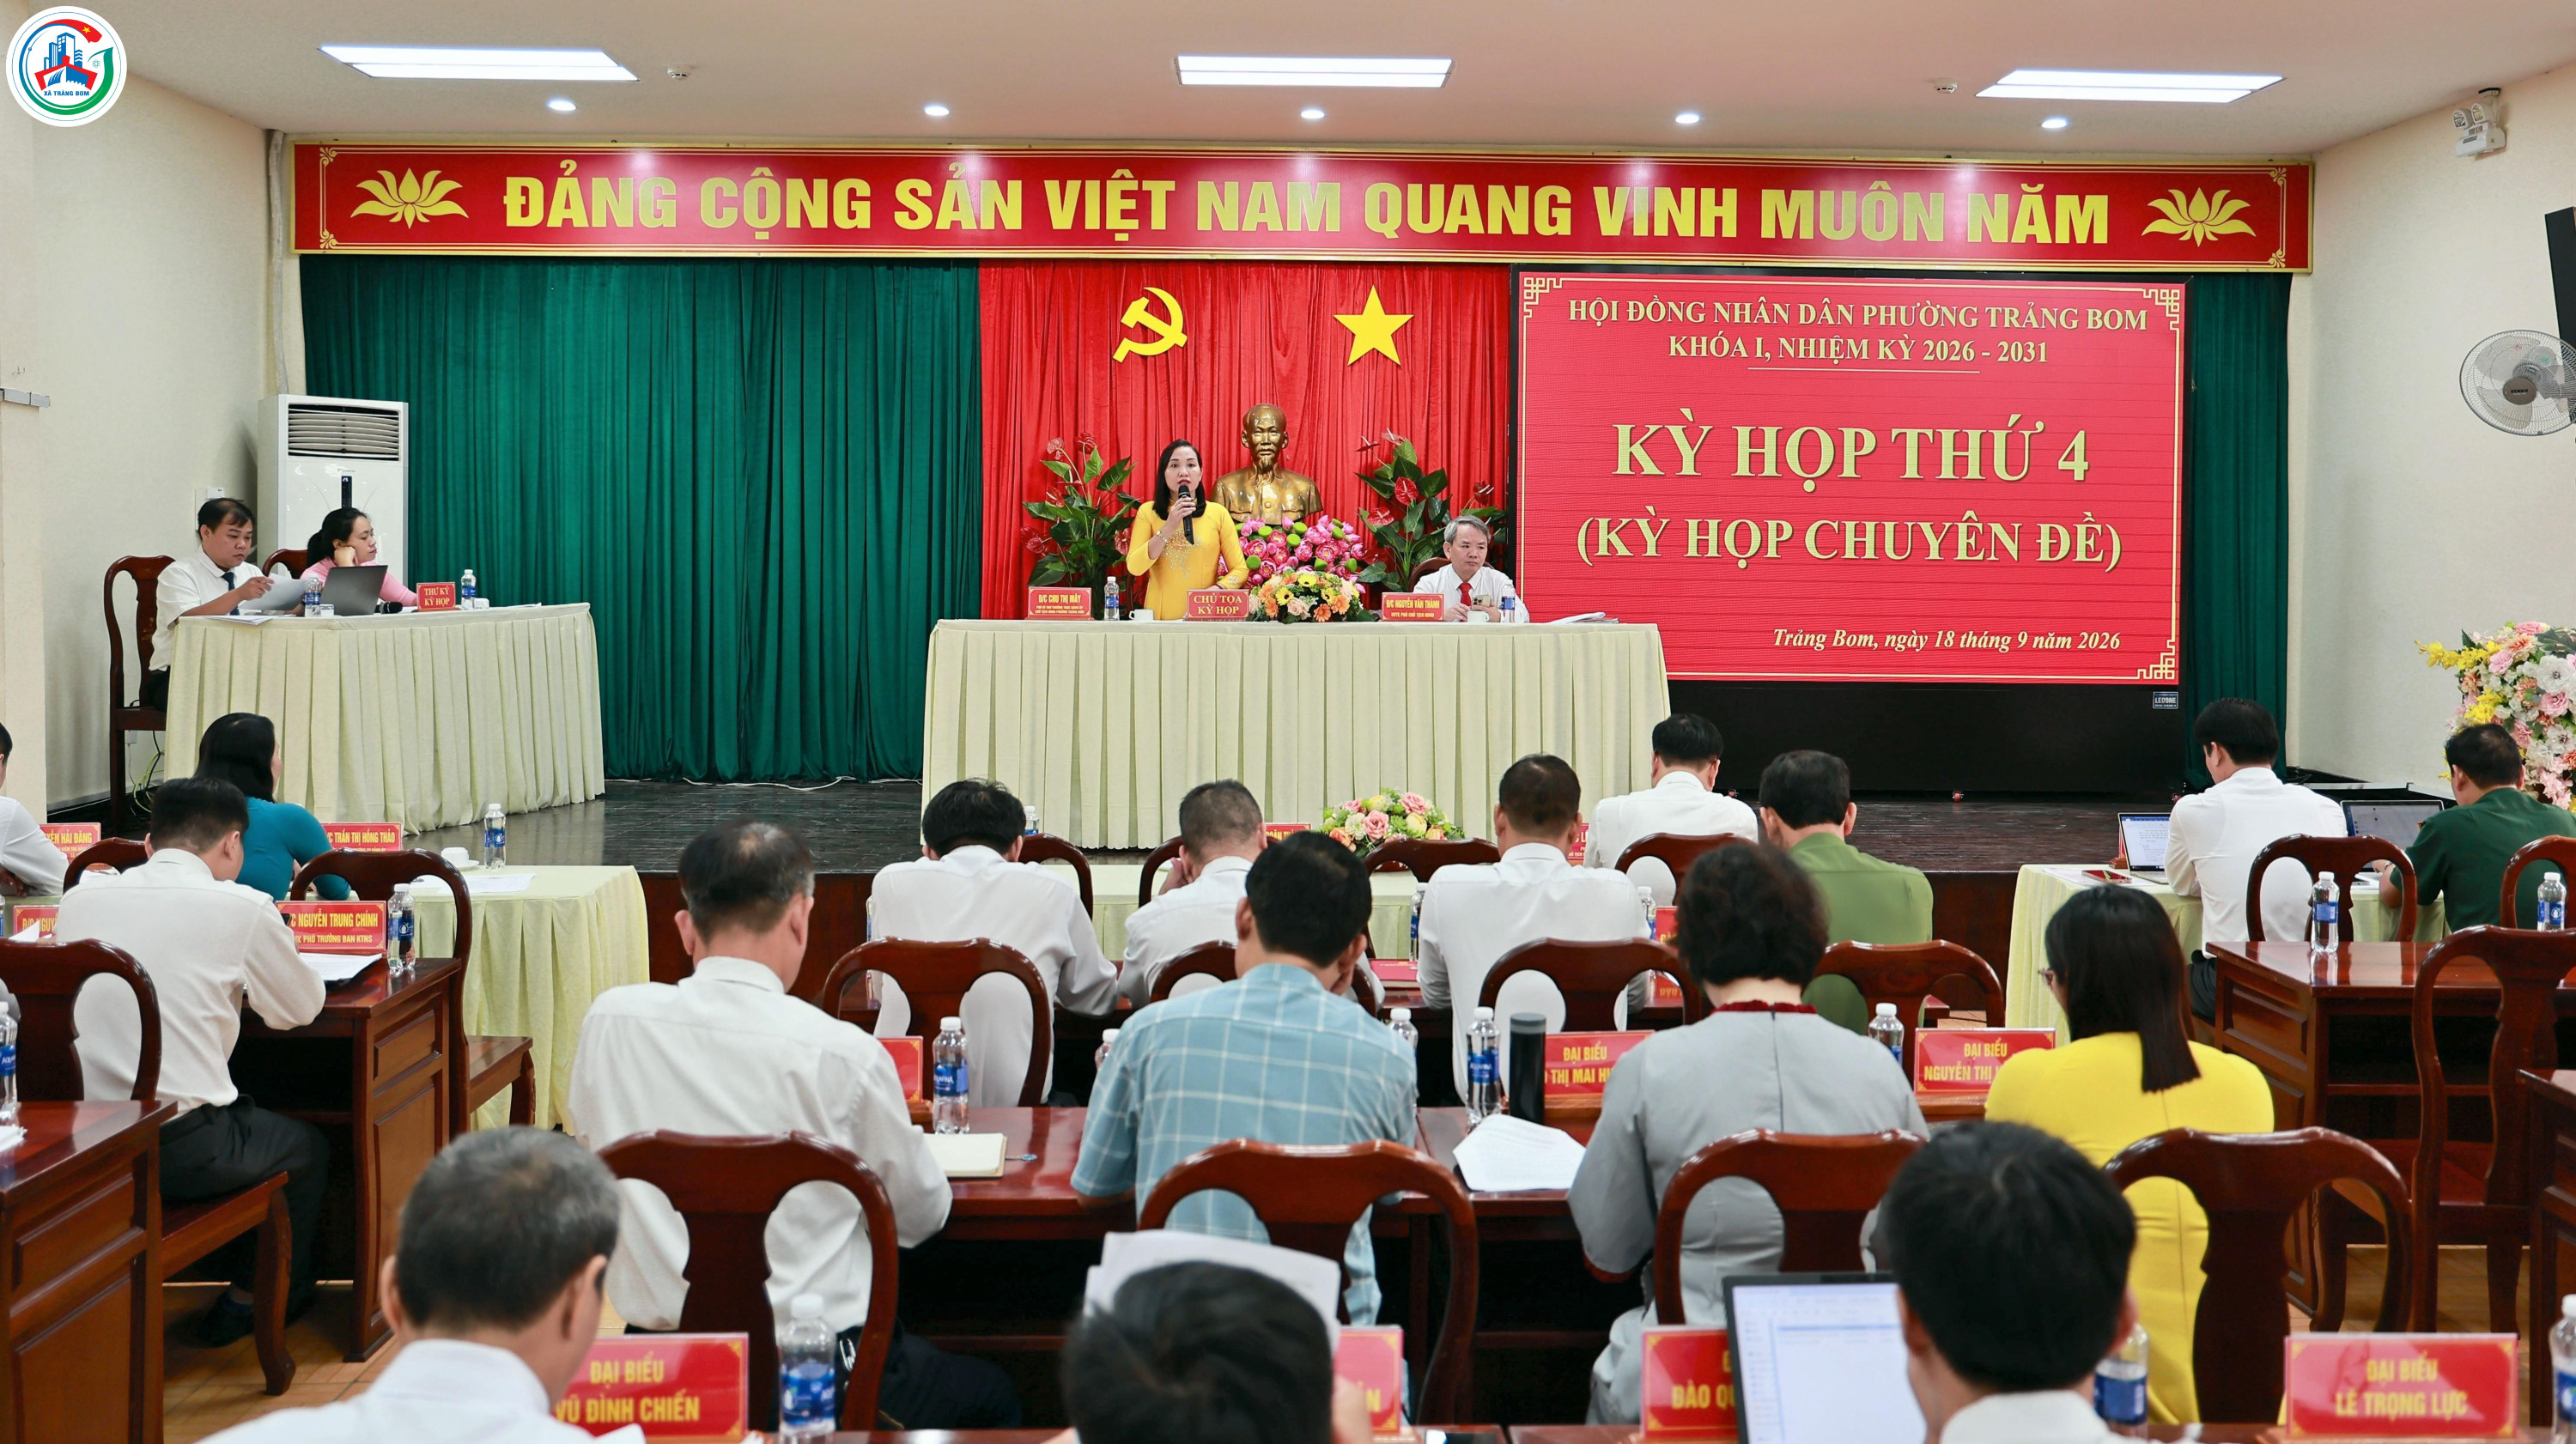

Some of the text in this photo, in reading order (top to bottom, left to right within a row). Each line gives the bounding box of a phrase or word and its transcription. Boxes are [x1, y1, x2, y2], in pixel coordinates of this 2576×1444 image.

[504, 159, 2109, 246] ĐẢNG CỘNG SẢN VIỆT NAM QUANG VINH MUÔN NĂM
[1570, 298, 2147, 330] HỘI ĐỒNG NHÂN DÂN PHƯỜNG TRẢNG BOM
[1668, 337, 1748, 357] KHÓA
[1755, 337, 1771, 361] I,
[1778, 336, 1869, 364] NHIỆM
[1877, 340, 1915, 360] KỲ
[1923, 340, 1974, 361] 2026
[1998, 342, 2046, 361] 2031
[1613, 409, 2088, 492] KỲ HỌP THỨ 4
[1578, 506, 2120, 572] (KỲ HỌP CHUYÊN ĐỀ)
[423, 586, 439, 596] THƯ
[424, 596, 451, 607] KỲ HỌP
[1048, 594, 1060, 604] CHU
[1060, 594, 1069, 605] THỊ
[1194, 592, 1242, 605] CHỦ TỌA
[1198, 604, 1239, 616] KỲ HỌP
[1774, 629, 2120, 652] Trảng Bom, ngày 18 tháng 9 năm 2026
[61, 828, 73, 844] HẢI
[74, 829, 93, 844] ĐĂNG
[351, 832, 361, 846] THỊ
[380, 828, 396, 844] THẢO
[299, 908, 328, 928] NGUYỄN
[330, 913, 354, 928] TRUNG
[356, 909, 379, 928] CHÍNH
[302, 934, 315, 943] PHÓ
[343, 935, 355, 943] BAN
[356, 934, 373, 943] KTNS
[1563, 1041, 1607, 1065] ĐẠI BIỂU
[1964, 1037, 2008, 1061] ĐẠI BIỂU
[1551, 1068, 1569, 1087] THỊ
[1572, 1068, 1595, 1083] MAI
[1924, 1061, 1971, 1082] NGUYỄN
[1974, 1066, 1992, 1084] THỊ
[590, 1350, 665, 1389] ĐẠI BIỂU
[2366, 1350, 2439, 1387] ĐẠI BIỂU
[1671, 1378, 1710, 1410] ĐÀO
[2336, 1386, 2469, 1423] LÊ TRỌNG LỰC
[556, 1394, 580, 1423] VŨ
[586, 1392, 635, 1423] ĐÌNH
